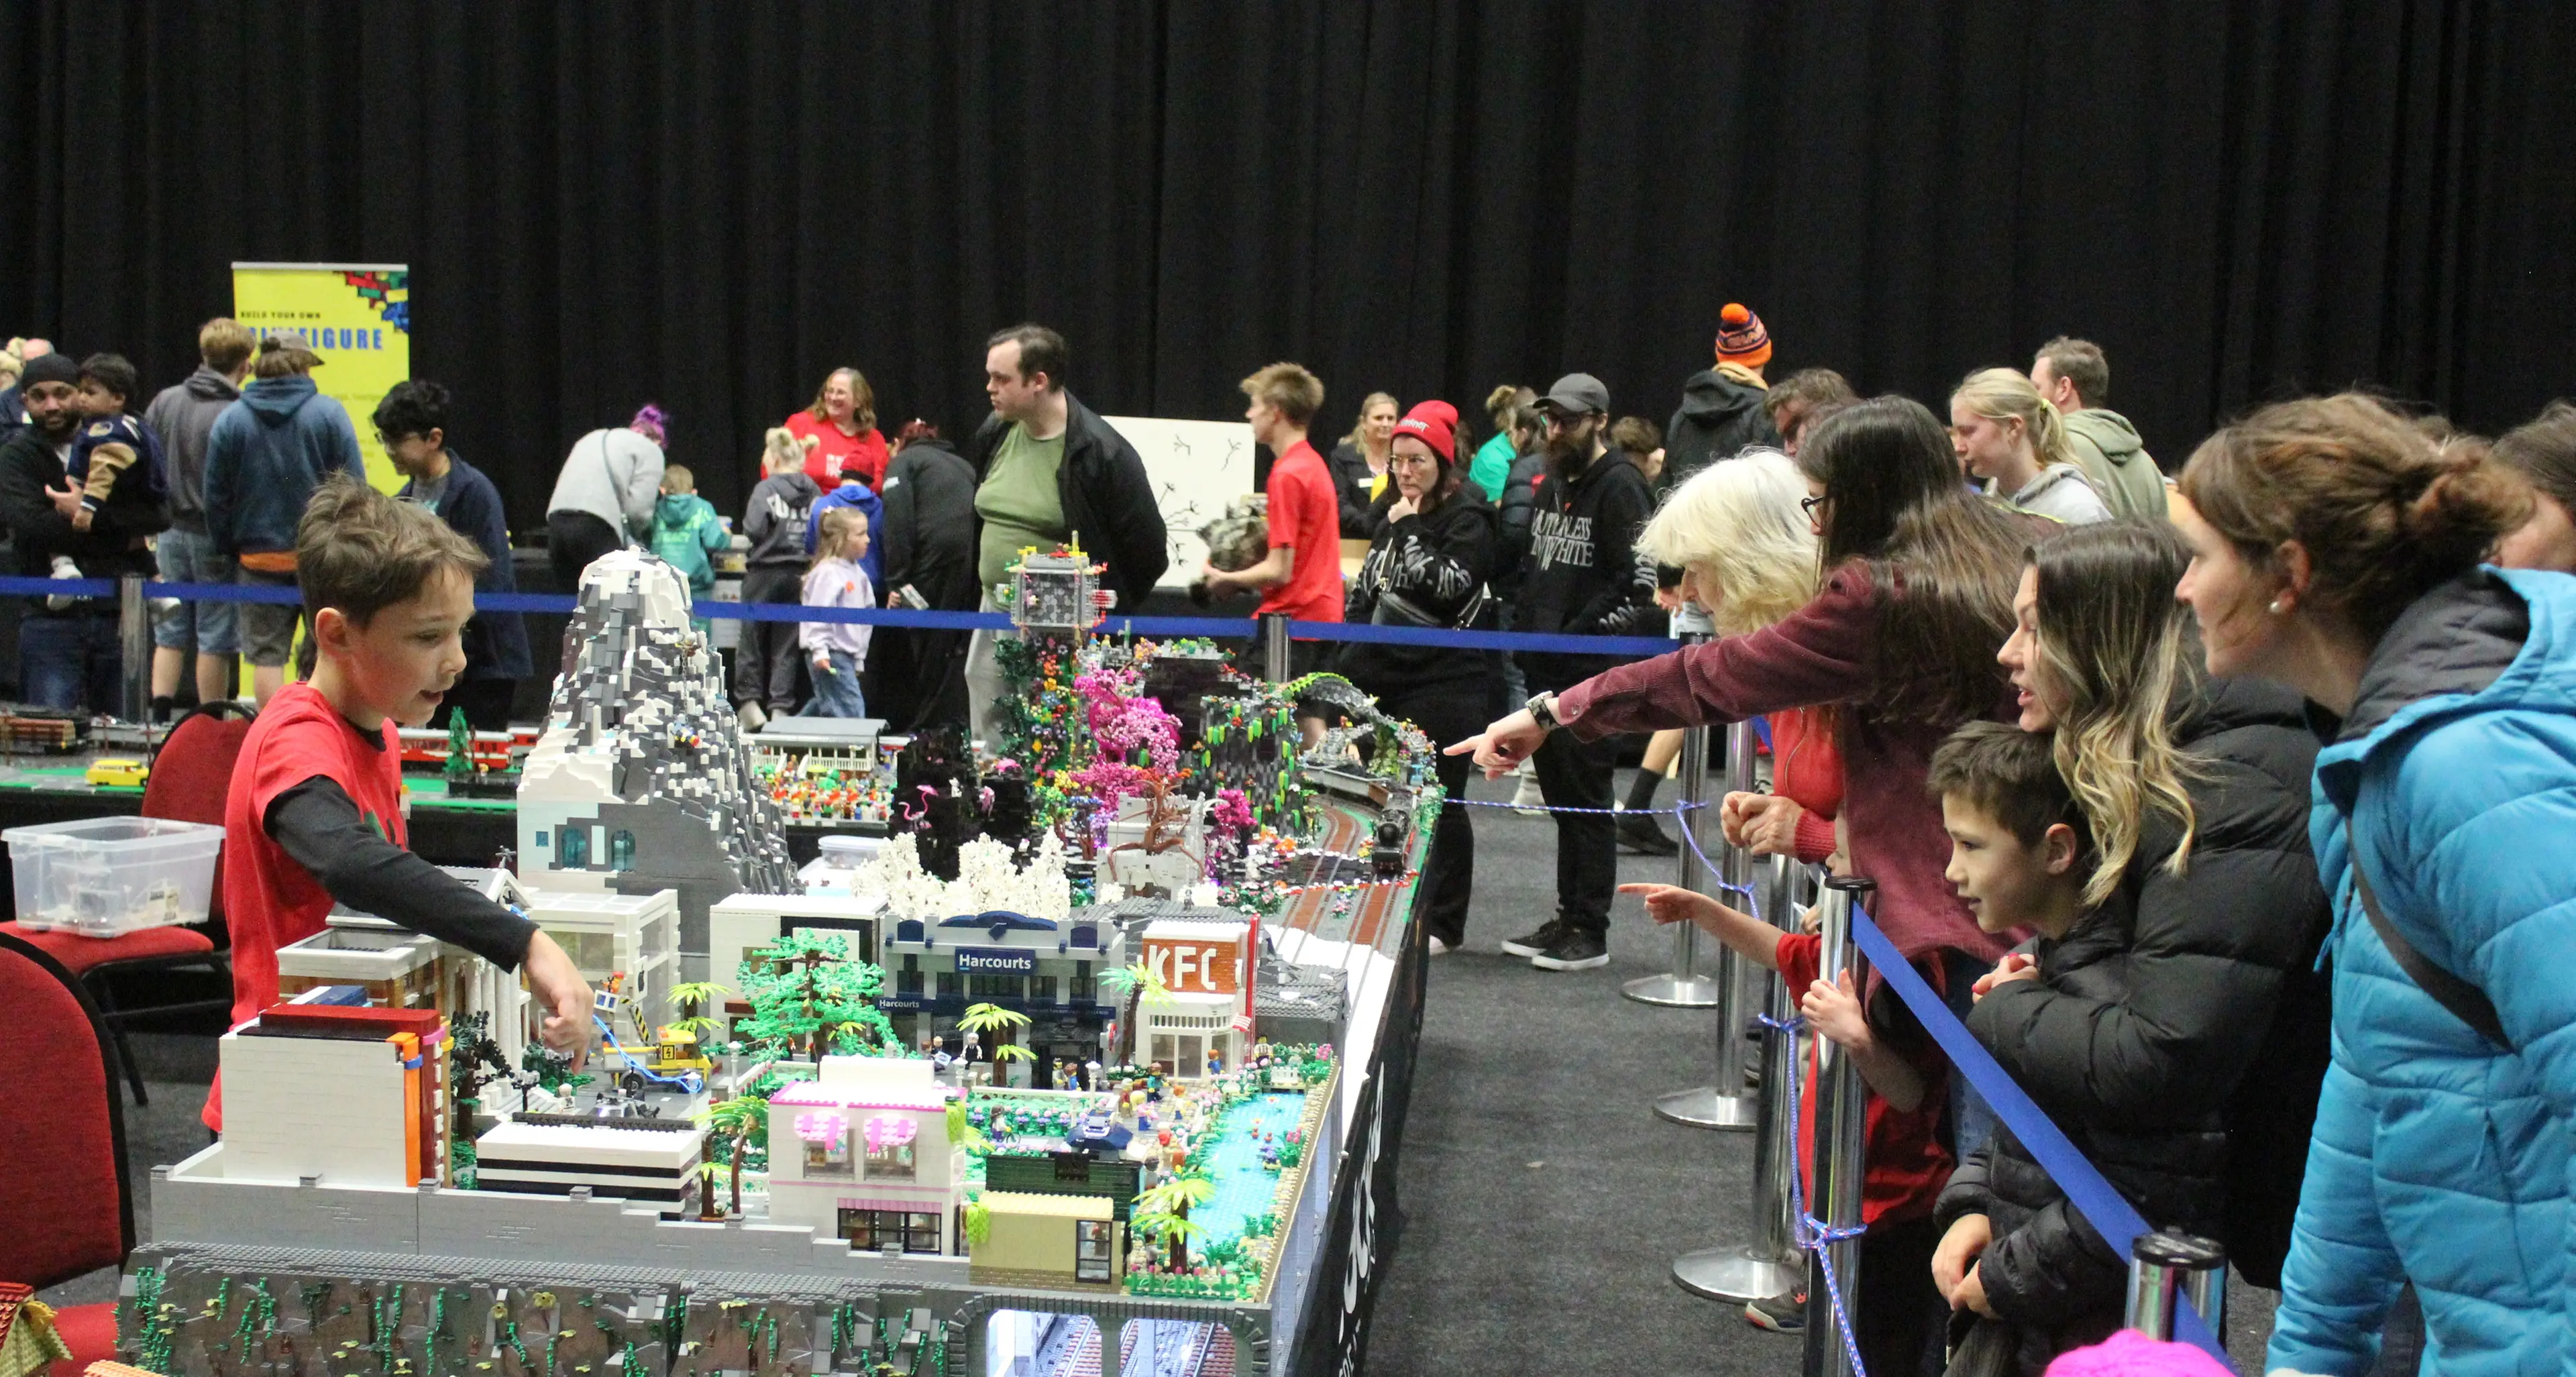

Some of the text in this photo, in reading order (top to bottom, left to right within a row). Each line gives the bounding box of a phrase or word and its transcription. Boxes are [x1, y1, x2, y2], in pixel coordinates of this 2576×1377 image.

[240, 311, 321, 319] BUILD YOUR OWN
[959, 953, 1032, 971] Harcourts
[1148, 944, 1217, 991] KFC
[879, 999, 920, 1008] Harcourts
